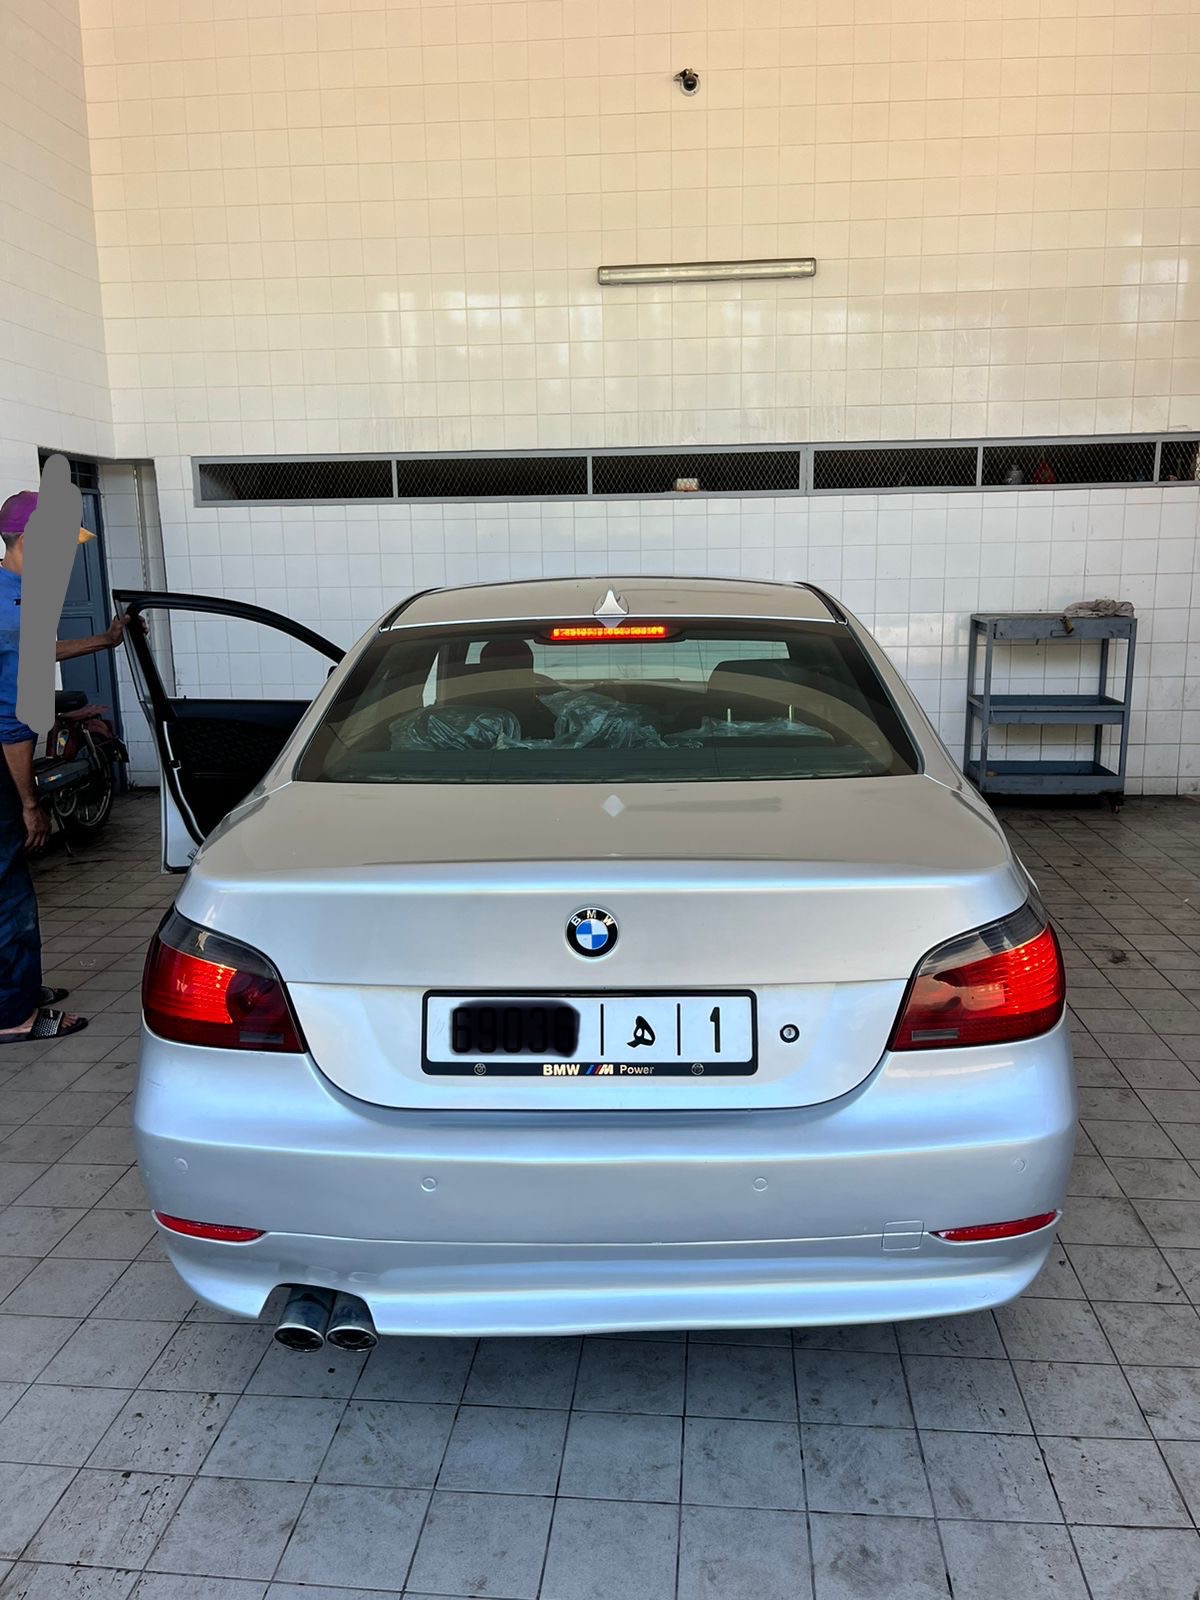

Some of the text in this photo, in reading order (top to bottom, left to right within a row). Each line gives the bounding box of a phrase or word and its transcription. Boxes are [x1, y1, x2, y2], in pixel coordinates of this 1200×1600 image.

[570, 908, 615, 927] BMW
[709, 1006, 721, 1053] 1
[543, 1064, 580, 1076] BMW
[619, 1064, 655, 1076] Power
